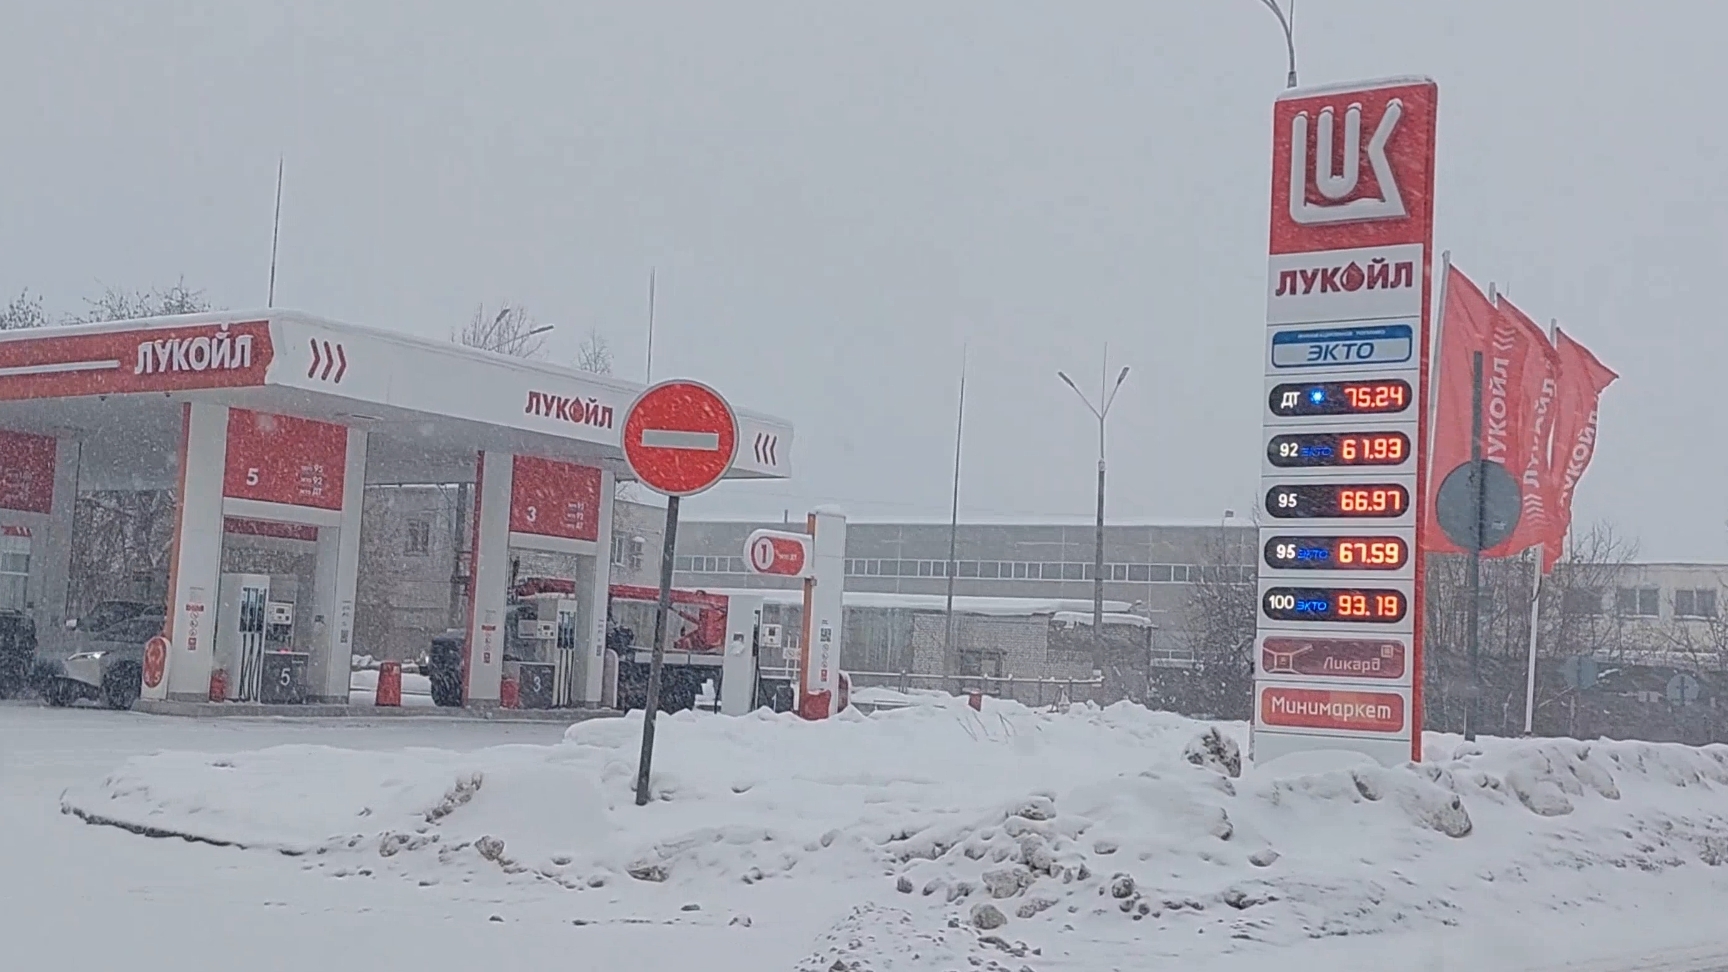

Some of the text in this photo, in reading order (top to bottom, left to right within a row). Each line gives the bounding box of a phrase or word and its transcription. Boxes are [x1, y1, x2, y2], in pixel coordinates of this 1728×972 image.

[1275, 258, 1412, 296] ЛУКОЙЛ
[135, 330, 253, 374] ЛУКОЙЛ
[1307, 342, 1375, 362] ЭКТО
[1280, 386, 1404, 411] ДТ 75.24
[525, 391, 613, 429] ЛУКОЙЛ
[1280, 443, 1299, 457] 92
[1342, 438, 1402, 460] 61.93
[246, 468, 259, 486] 5
[1278, 491, 1401, 512] 95 66.97
[526, 506, 537, 522] 3
[1276, 544, 1296, 559] 95
[1339, 543, 1399, 564] 67.59
[1269, 594, 1398, 617] 100 ЭКТО 93.19
[1323, 655, 1381, 675] Ликард
[280, 668, 291, 686] 5
[533, 676, 541, 692] 3
[1271, 697, 1392, 725] Минимаркет
